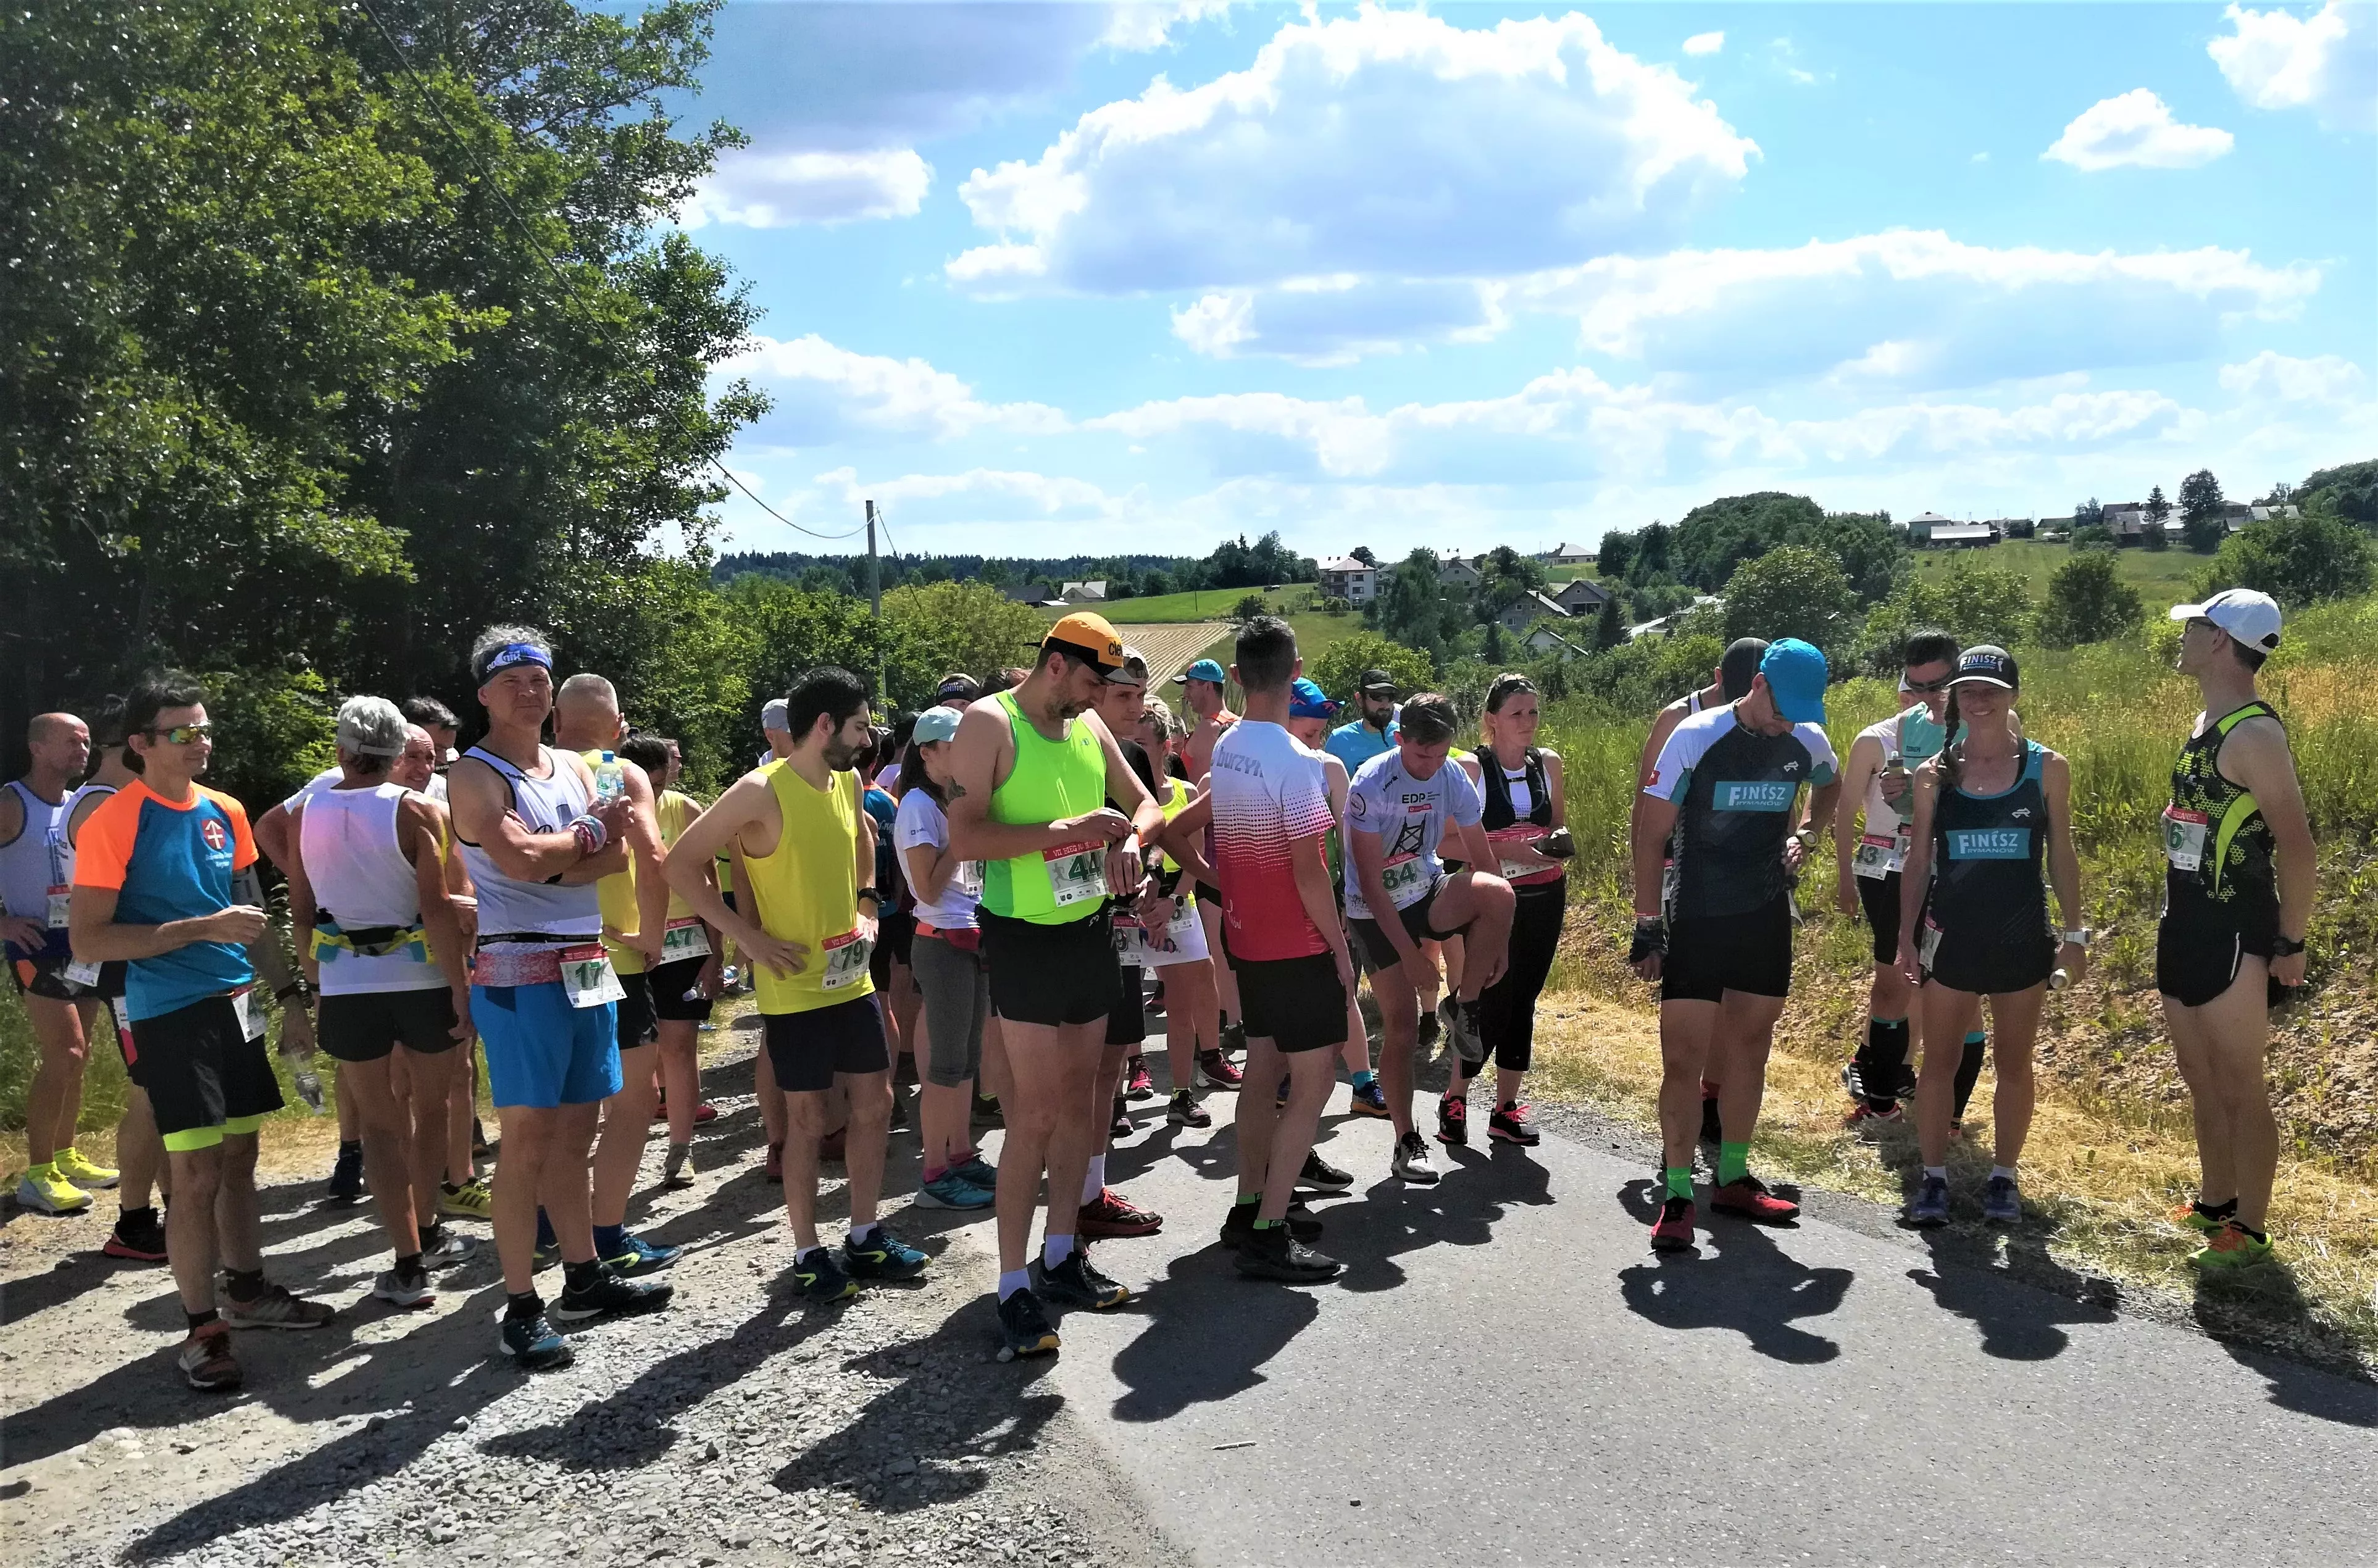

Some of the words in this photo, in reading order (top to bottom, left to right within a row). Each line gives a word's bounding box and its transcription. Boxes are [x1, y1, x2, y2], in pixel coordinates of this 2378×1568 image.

[1402, 793, 1425, 804] EDP
[1062, 845, 1077, 854] BIEG
[1068, 852, 1101, 882] 44
[1382, 861, 1417, 890] 84
[663, 927, 693, 949] 47
[840, 941, 864, 972] 79
[575, 961, 601, 990] 17
